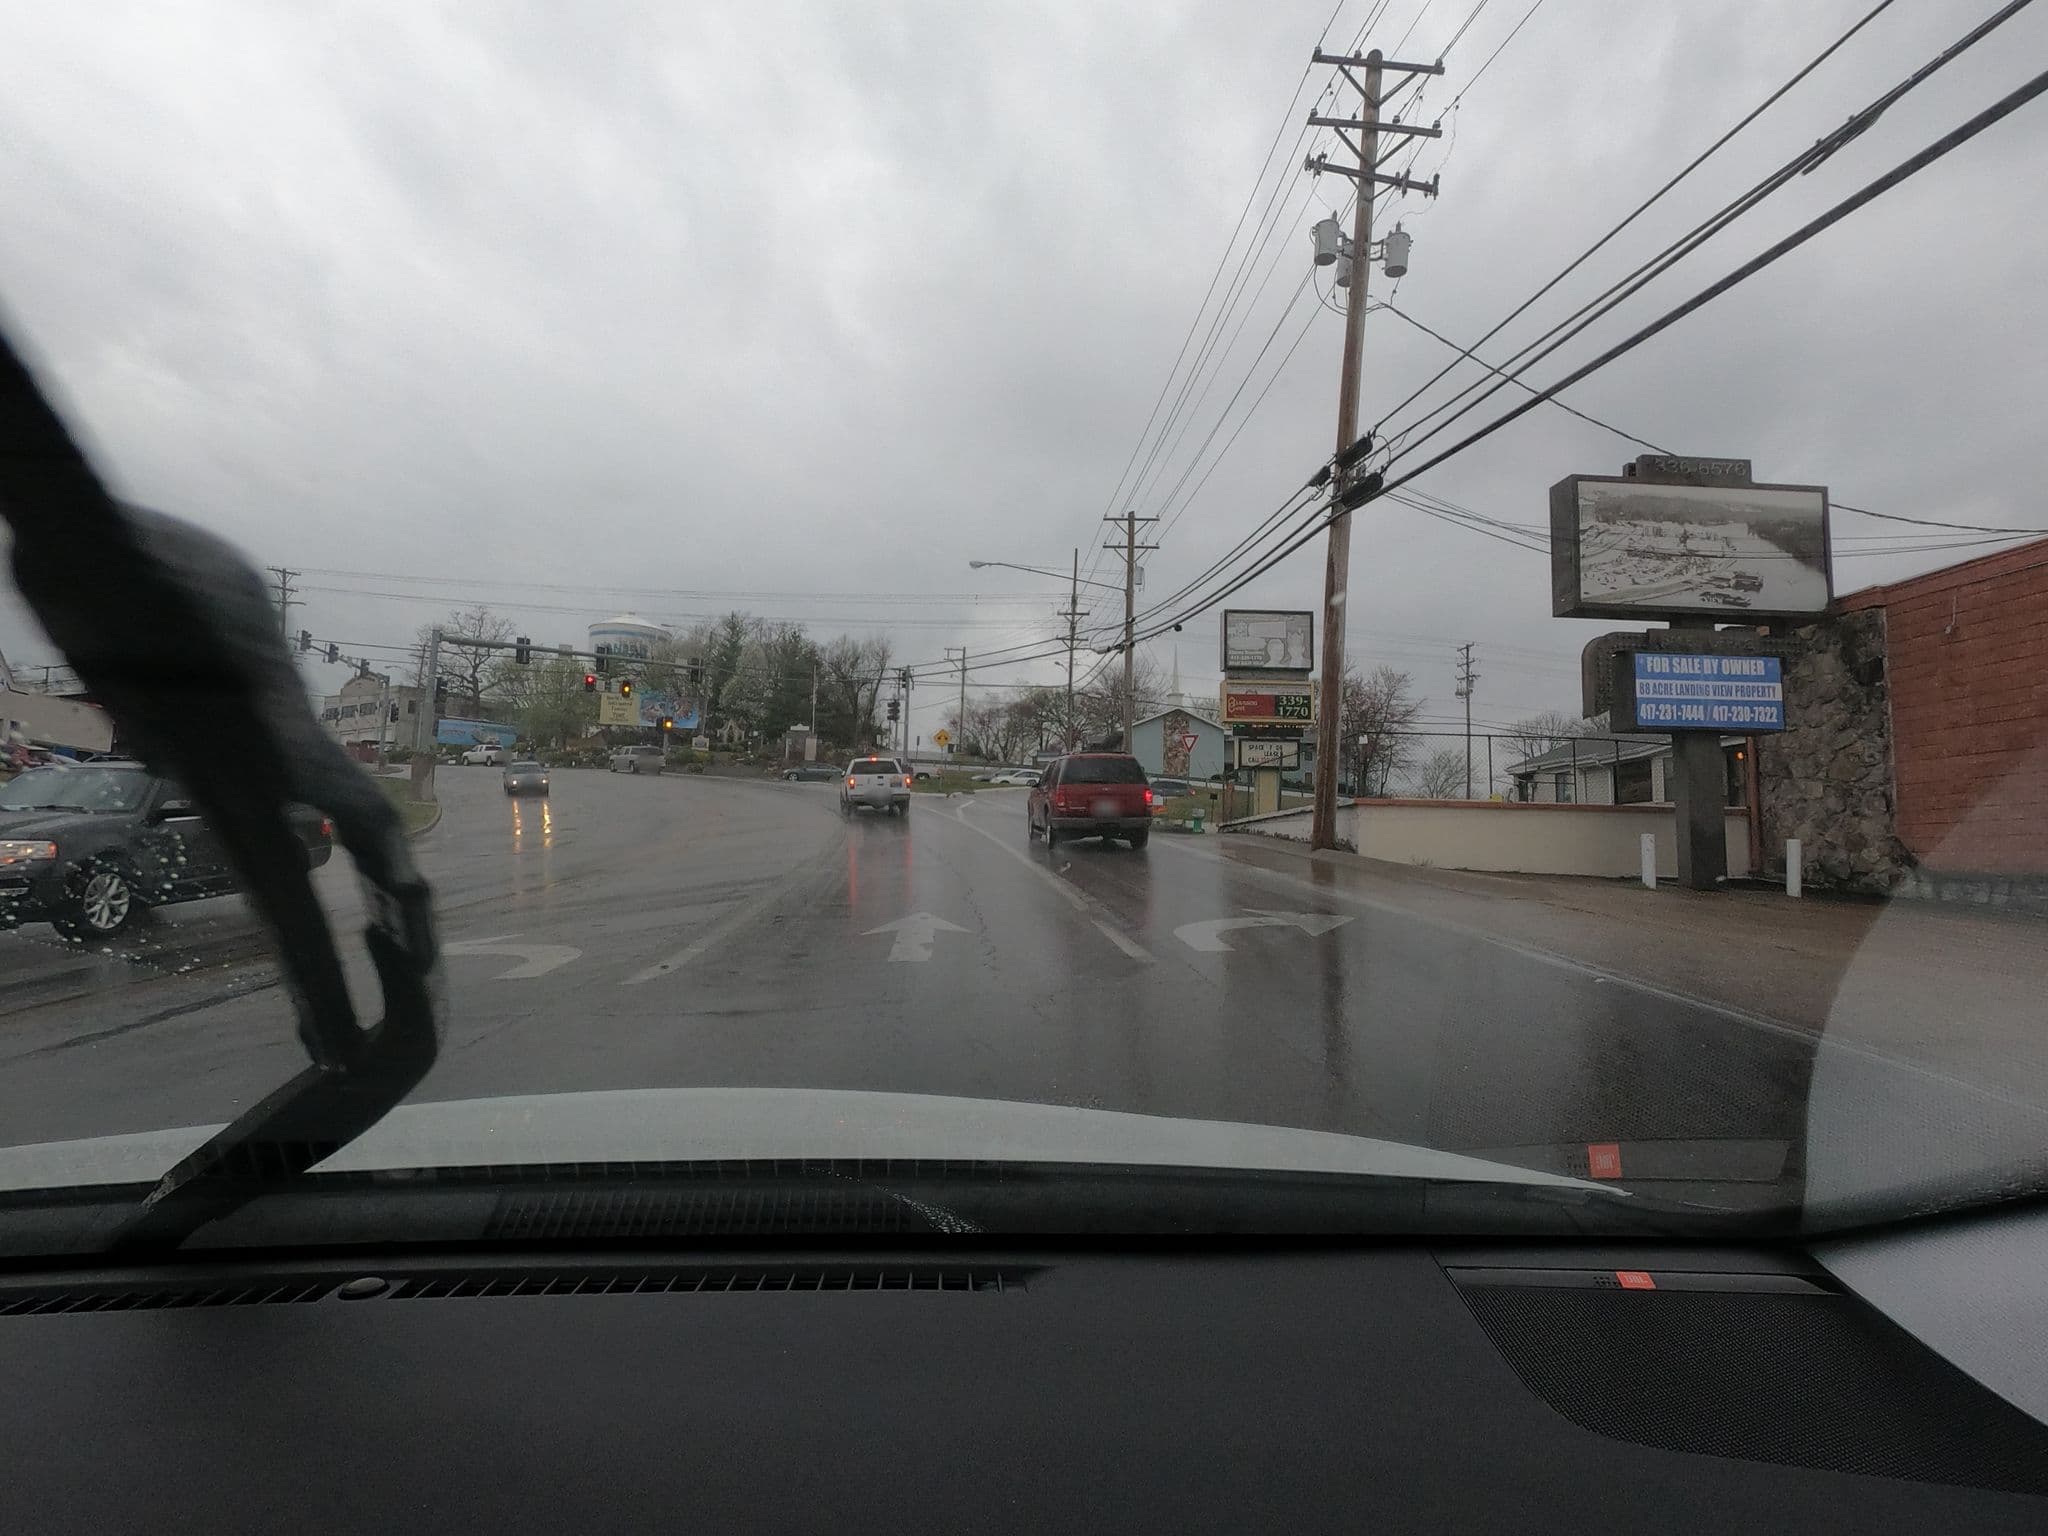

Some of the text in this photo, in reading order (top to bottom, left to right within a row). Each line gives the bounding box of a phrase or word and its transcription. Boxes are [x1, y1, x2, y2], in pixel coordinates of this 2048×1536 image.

[1646, 656, 1765, 676] FOR SALE BY OWNER
[1652, 683, 1673, 697] ACRE
[1675, 683, 1711, 697] LANDING
[1711, 684, 1733, 697] VIEW
[1735, 685, 1777, 698] PROPERTY
[1279, 706, 1309, 717] 1770
